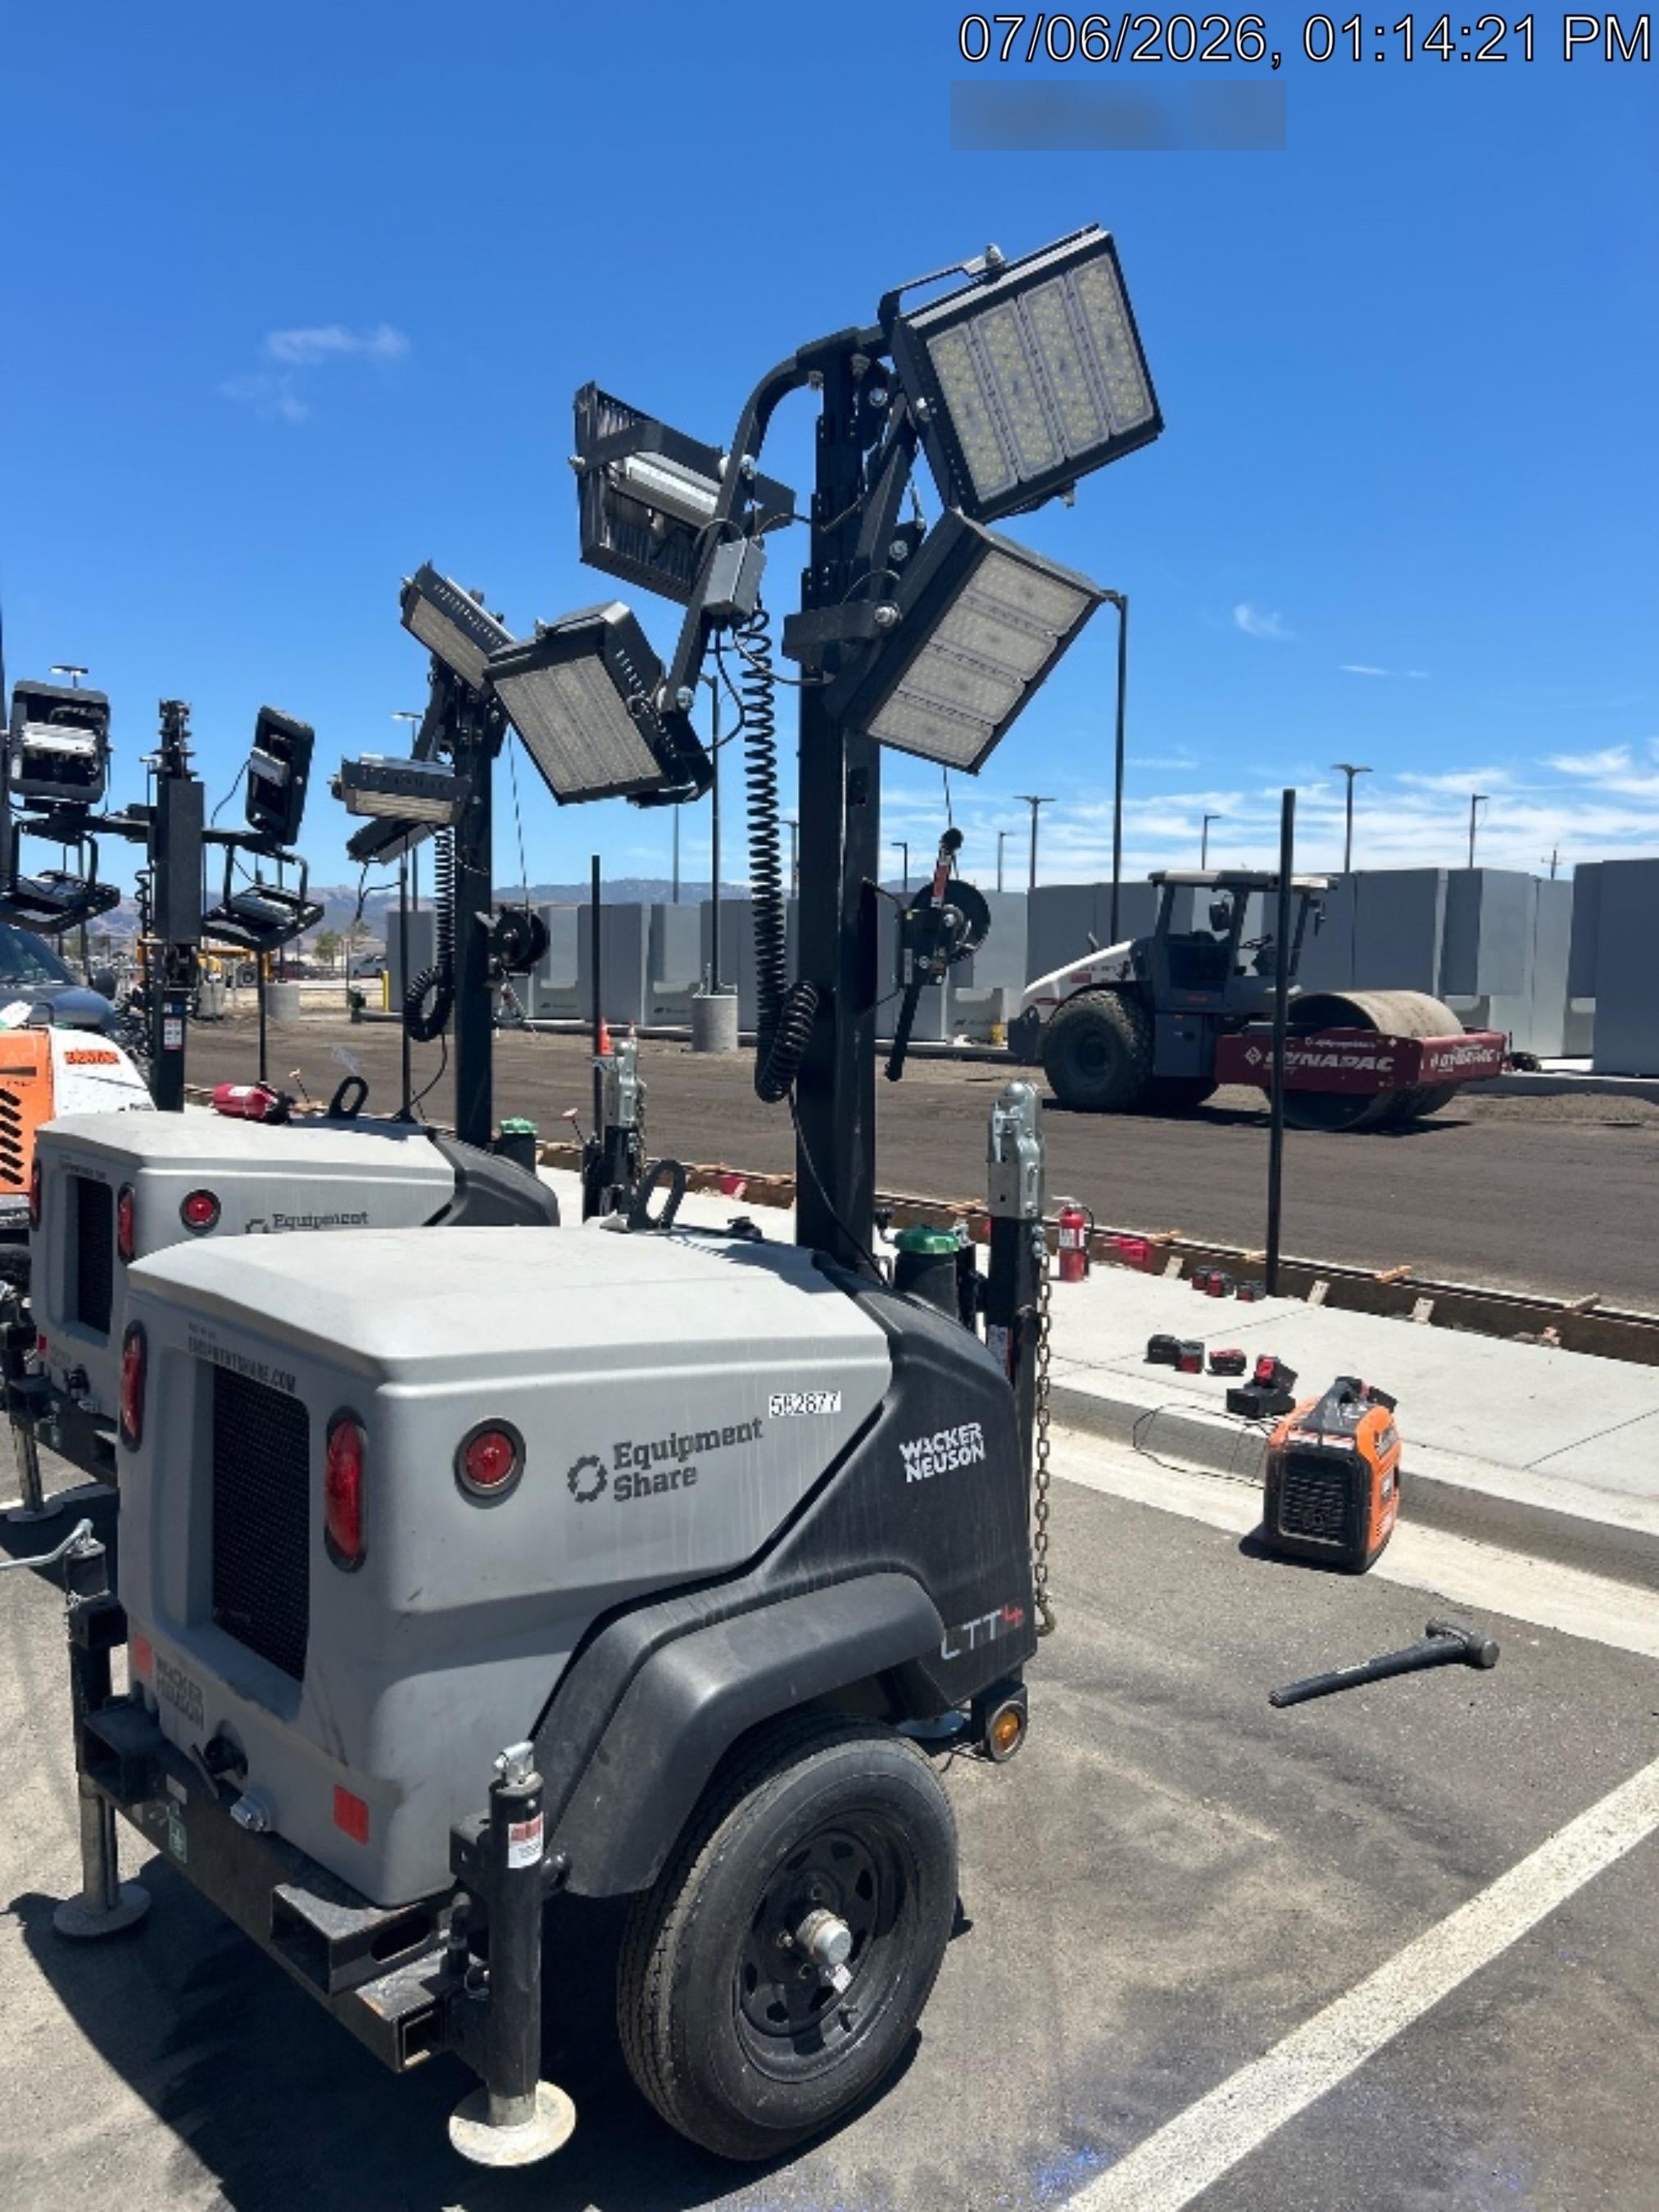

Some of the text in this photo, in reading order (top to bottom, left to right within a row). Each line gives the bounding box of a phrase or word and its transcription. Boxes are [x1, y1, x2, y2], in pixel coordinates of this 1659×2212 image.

[613, 1416, 764, 1470] Equipment
[899, 1422, 984, 1459] WACKER
[904, 1440, 986, 1483] NEUSON
[614, 1466, 697, 1502] Share
